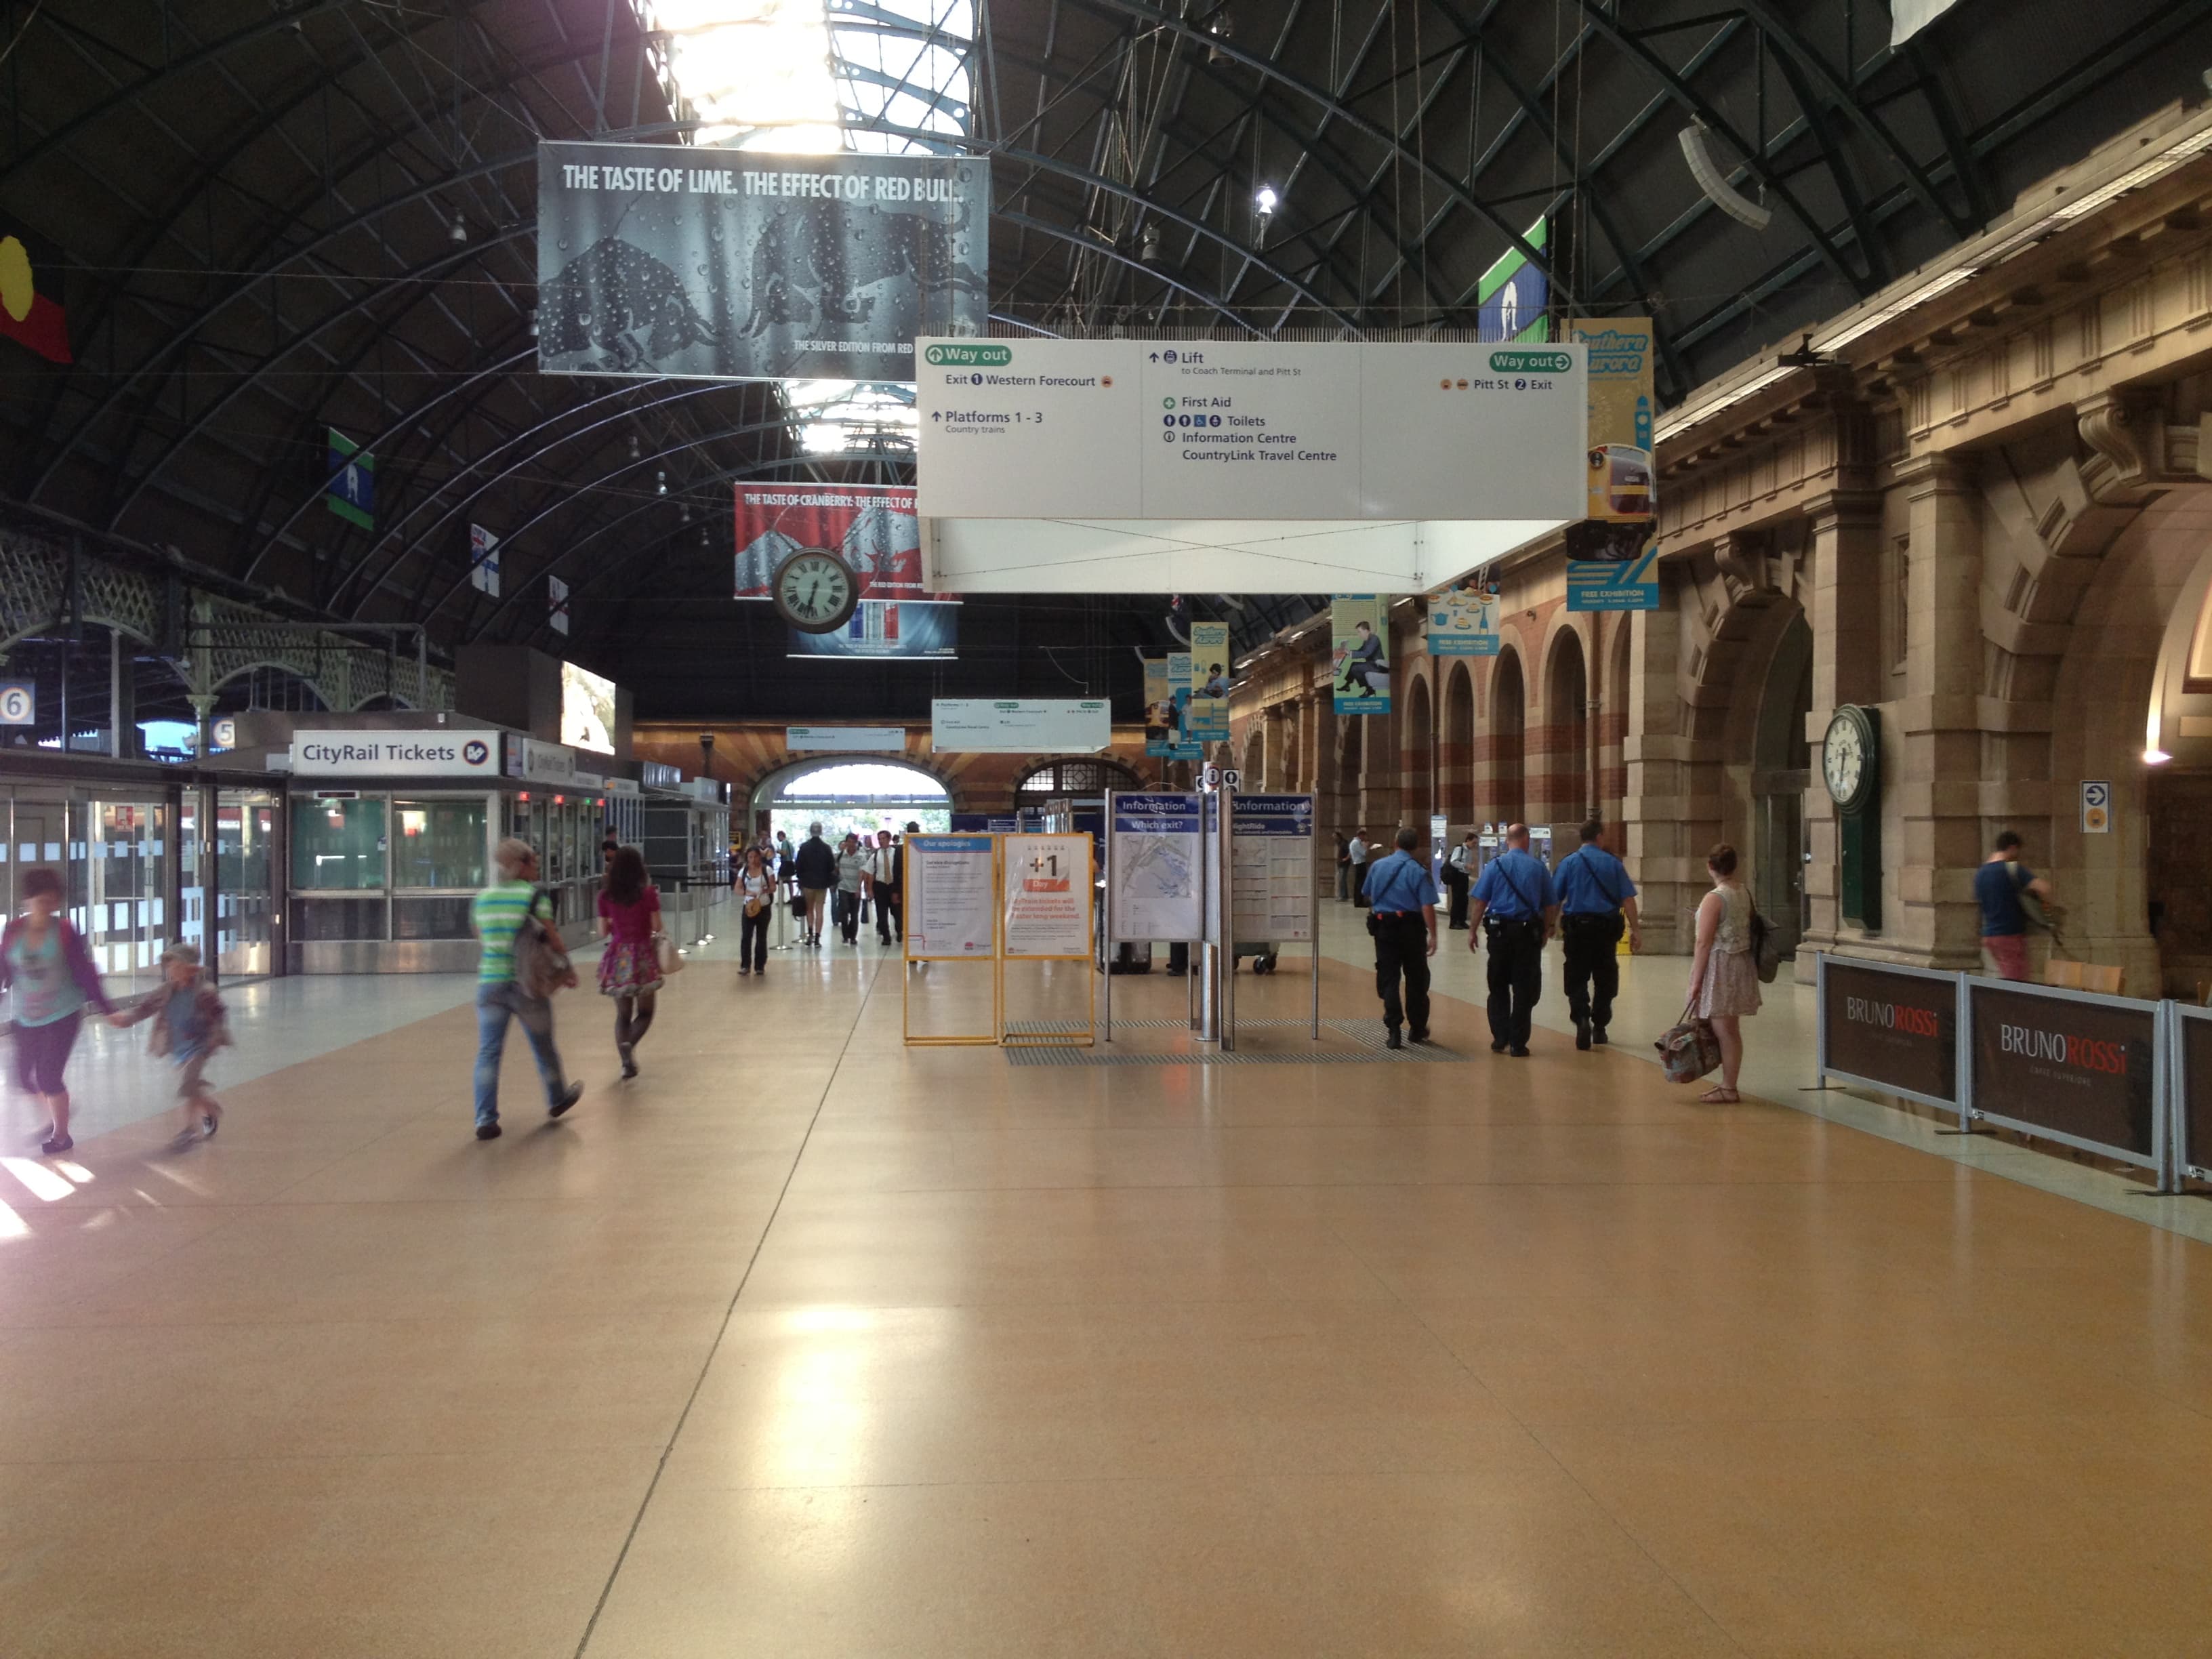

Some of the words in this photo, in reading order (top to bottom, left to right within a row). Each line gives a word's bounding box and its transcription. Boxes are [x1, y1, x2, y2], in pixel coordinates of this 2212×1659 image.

[563, 165, 599, 189] THE
[602, 166, 655, 191] TASTE
[657, 168, 683, 192] OF
[689, 169, 738, 194] LIME.
[743, 171, 778, 196] THE
[781, 173, 843, 198] EFFECT
[845, 175, 869, 199] OF
[875, 176, 911, 201] RED
[914, 178, 964, 203] BULL.
[794, 340, 809, 350] THE
[811, 341, 836, 352] SILVER
[838, 342, 870, 352] EDITION
[872, 342, 896, 353] FROM
[897, 343, 914, 354] RED
[946, 348, 978, 363] Way
[983, 349, 1008, 361] out
[1182, 352, 1204, 363] Lift
[1494, 355, 1525, 369] Way
[1529, 356, 1553, 367] out
[1588, 355, 1643, 373] urora
[946, 374, 968, 384] Exit
[987, 375, 1036, 386] Western
[1040, 376, 1095, 386] Forecourt
[1475, 380, 1494, 390] Pitt
[1498, 380, 1510, 390] St
[1531, 380, 1553, 390] Exit
[1182, 397, 1207, 407] First
[1211, 397, 1231, 407] Aid
[946, 411, 1010, 423] Platforms
[1015, 412, 1021, 423] 1
[1035, 412, 1043, 423] 3
[1227, 416, 1265, 426] Toilets
[946, 426, 979, 434] Country
[1183, 432, 1253, 443] Information
[1258, 433, 1296, 443] Centre
[1183, 450, 1254, 462] CountryLink
[1258, 450, 1294, 461] Travel
[1298, 451, 1336, 461] Centre
[745, 493, 761, 504] THE
[762, 494, 787, 505] TASTE
[787, 495, 800, 506] OF
[855, 496, 871, 507] THE
[872, 497, 901, 508] EFFECT
[901, 497, 913, 508] OF
[7, 693, 22, 716] 6
[220, 724, 232, 742] 5
[304, 744, 379, 764] CityRail
[386, 745, 455, 760] Tickets
[1123, 801, 1186, 810] Information
[1131, 820, 1159, 829] Which
[1161, 820, 1183, 829] exit?
